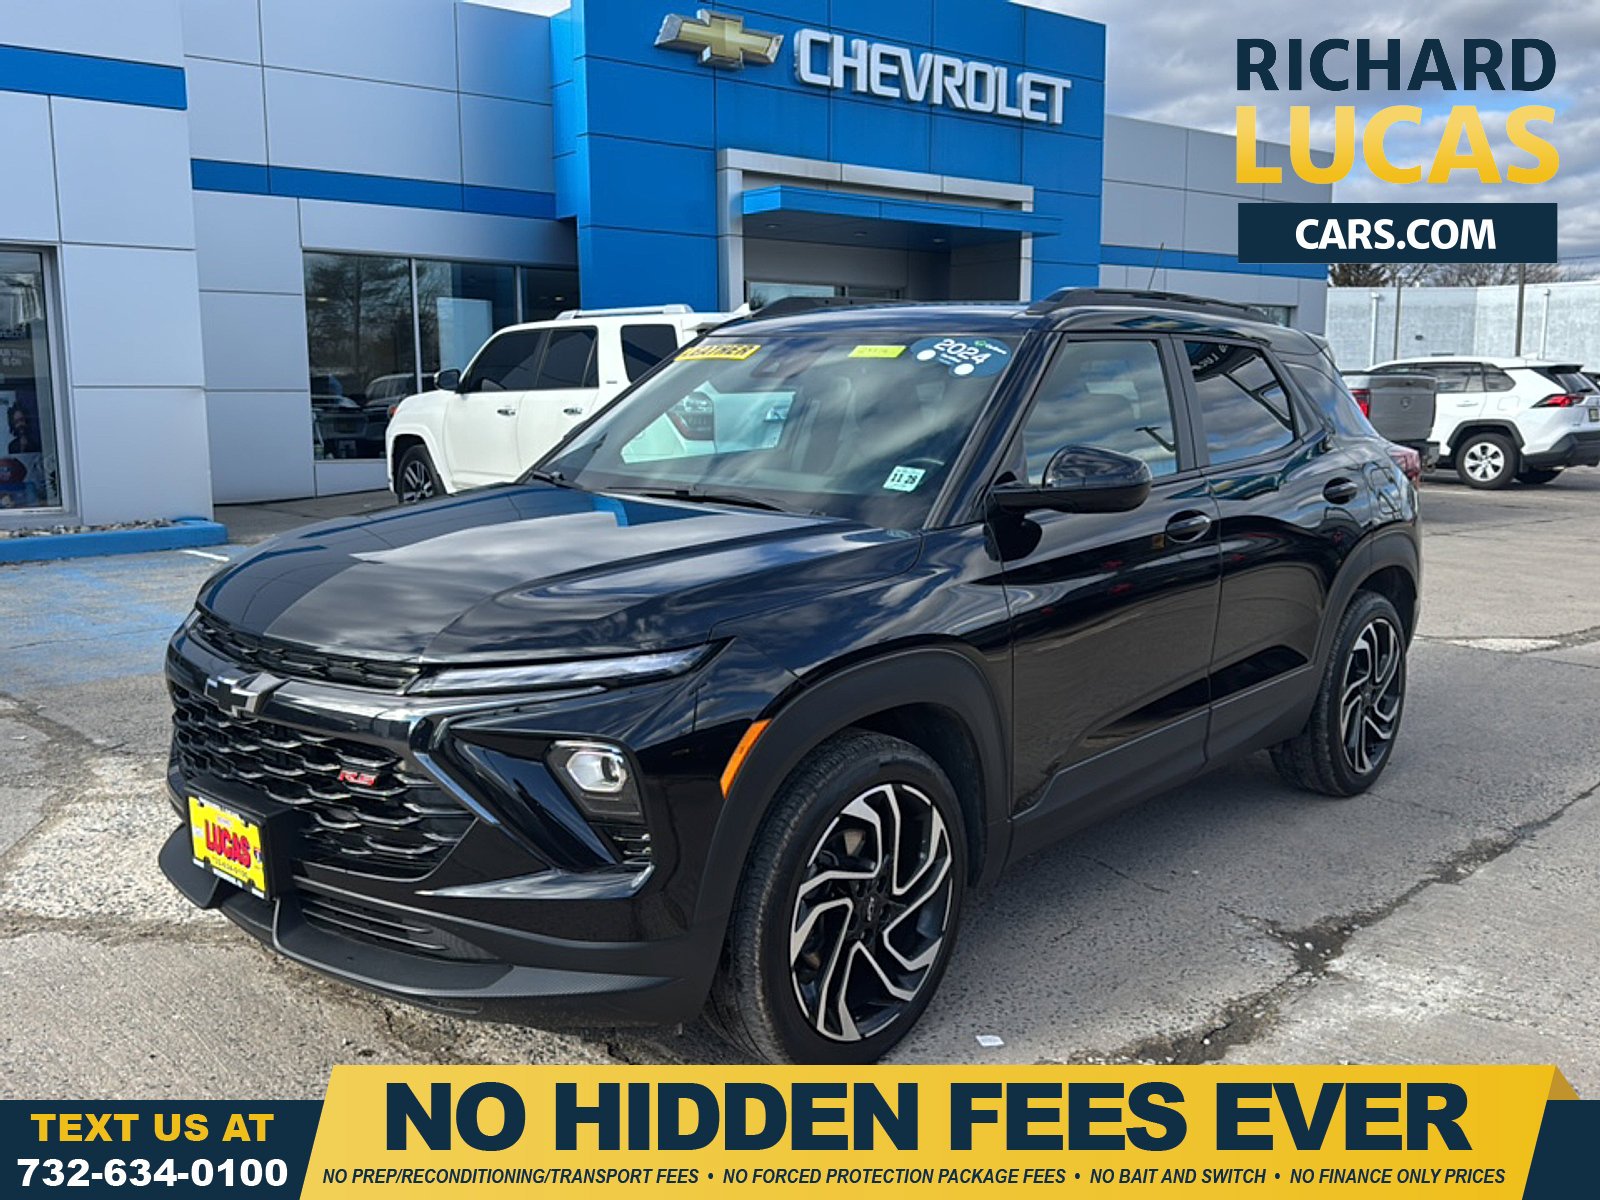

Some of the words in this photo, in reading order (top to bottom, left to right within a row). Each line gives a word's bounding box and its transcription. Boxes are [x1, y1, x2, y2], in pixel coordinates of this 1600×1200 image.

[794, 28, 1071, 125] CHEVROLET
[934, 338, 992, 365] 2024
[338, 770, 376, 786] RS
[205, 819, 251, 869] LUCAS
